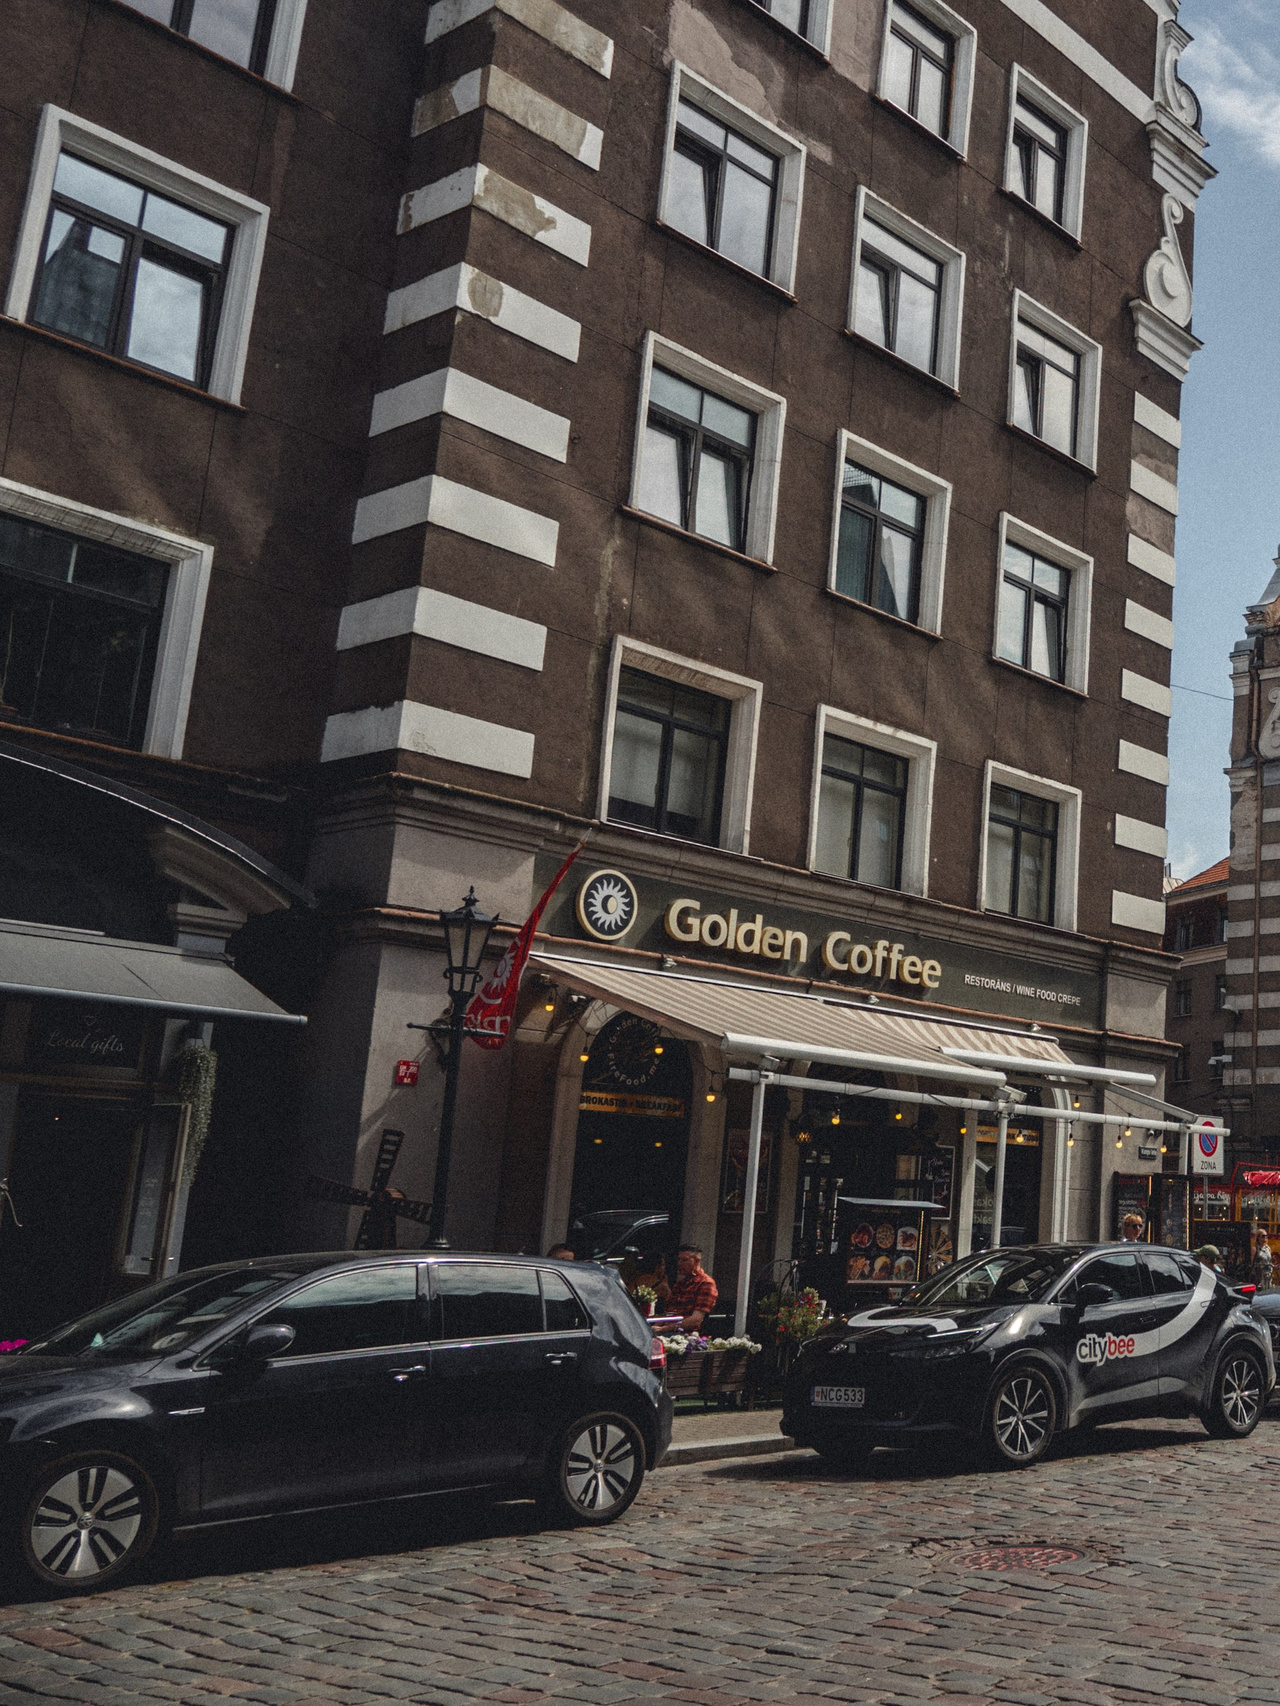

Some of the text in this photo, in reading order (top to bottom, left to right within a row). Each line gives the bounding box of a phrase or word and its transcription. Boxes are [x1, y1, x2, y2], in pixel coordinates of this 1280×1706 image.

[665, 898, 942, 989] Golden Coffee
[964, 974, 1012, 993] RESTORĀNS
[1016, 985, 1035, 998] WINE
[1036, 989, 1057, 1001] FOOD
[1057, 993, 1081, 1006] CREPE
[47, 1031, 125, 1056] Local gifts
[1200, 1160, 1217, 1170] ZONA
[1078, 1335, 1135, 1362] citybee
[821, 1388, 863, 1402] NCG533
